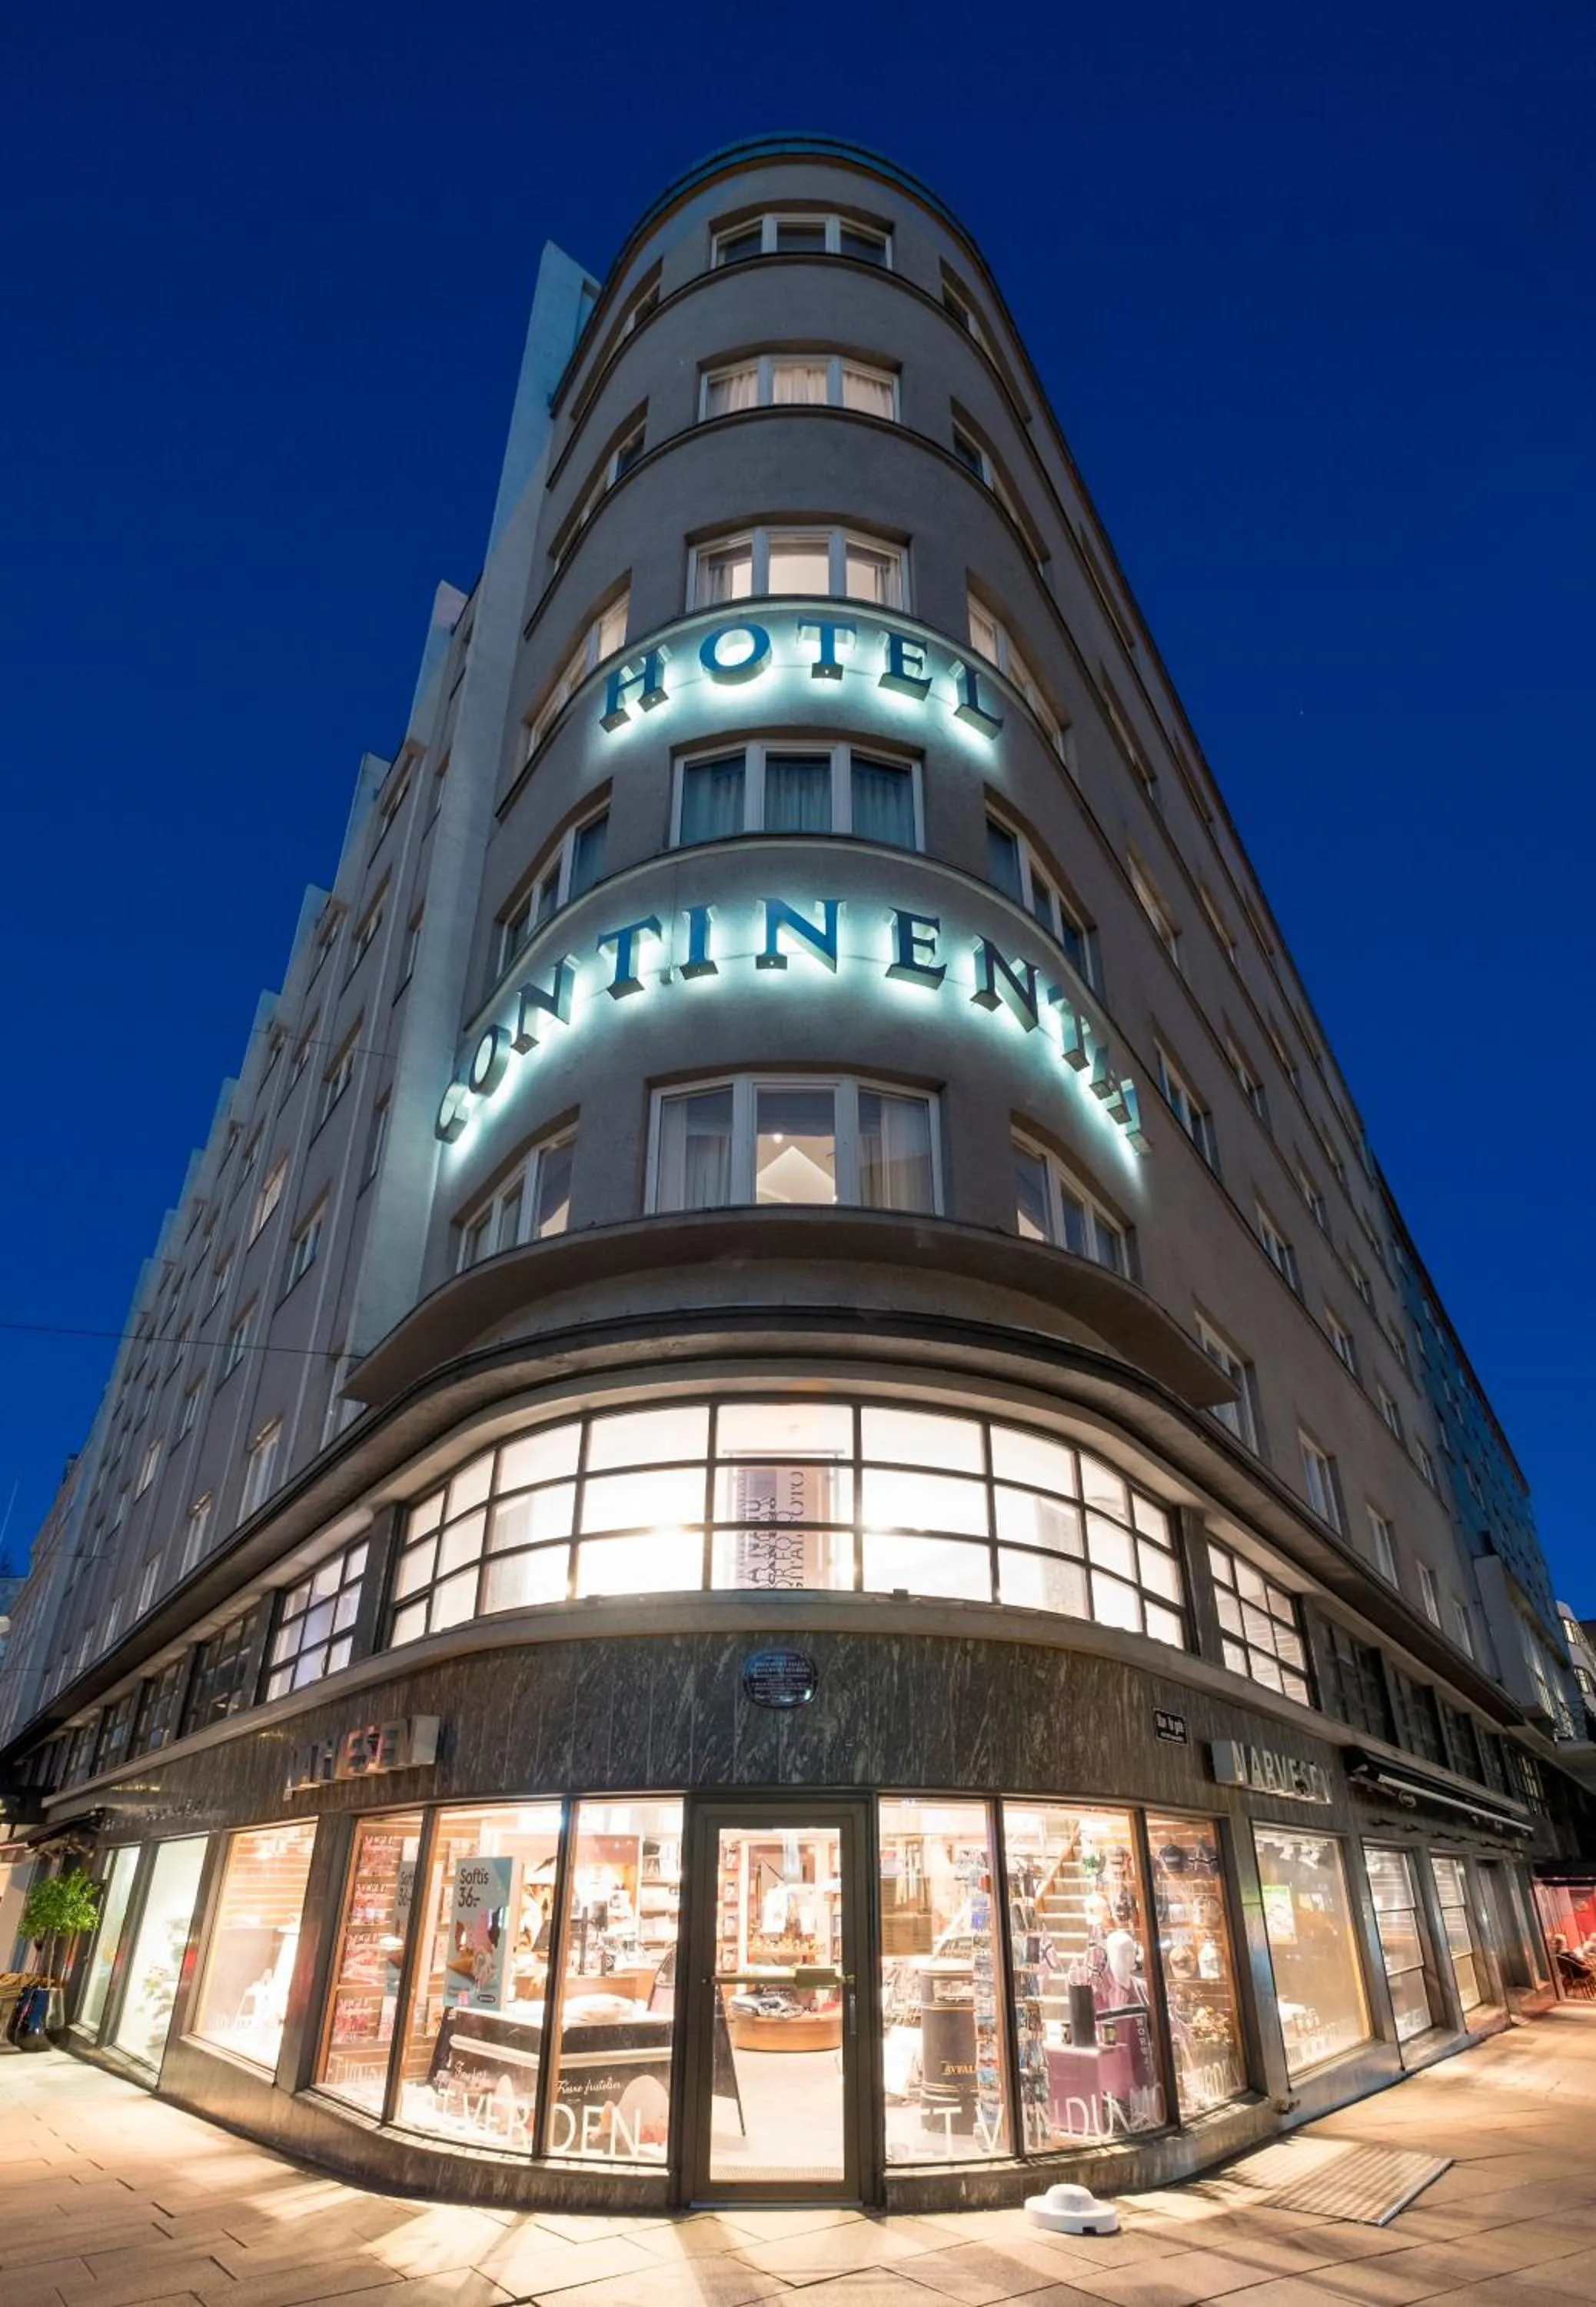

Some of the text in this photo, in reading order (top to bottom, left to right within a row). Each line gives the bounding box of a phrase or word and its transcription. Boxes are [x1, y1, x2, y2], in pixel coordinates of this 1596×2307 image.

[599, 618, 1003, 741] HOTEL
[434, 897, 1155, 1155] CONTINENTAL
[460, 1867, 489, 1885] Softis
